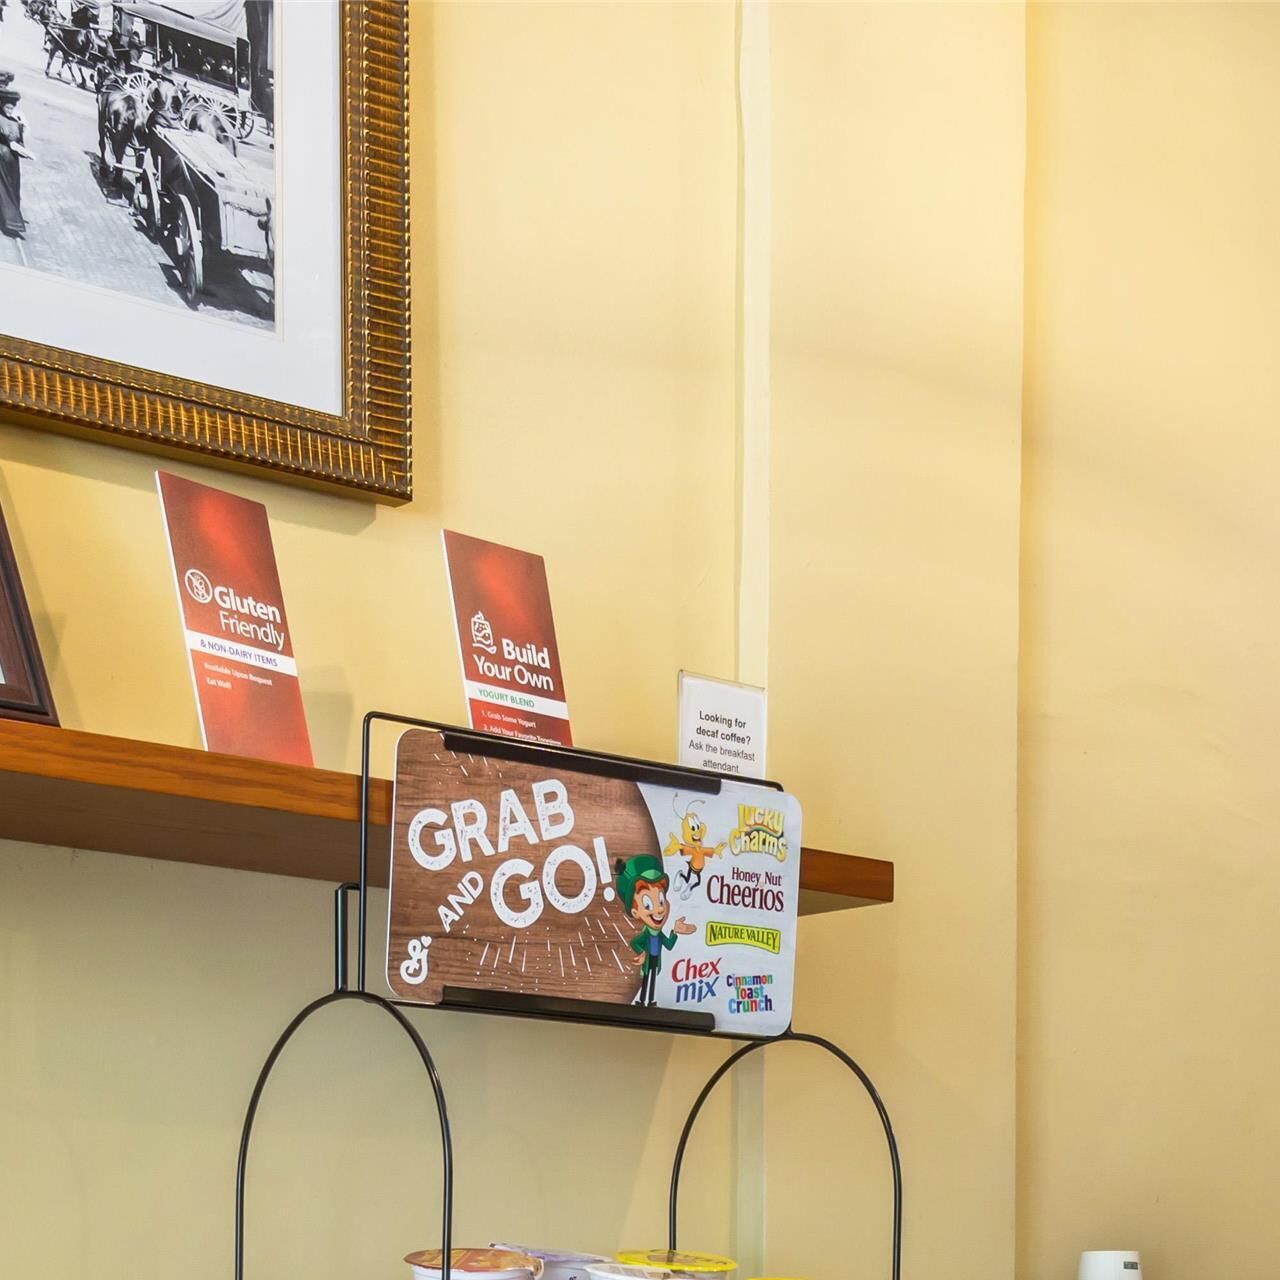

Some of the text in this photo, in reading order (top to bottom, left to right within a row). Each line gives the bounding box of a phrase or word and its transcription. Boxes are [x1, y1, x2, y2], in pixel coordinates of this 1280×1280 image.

[214, 586, 281, 624] Gluten
[219, 610, 285, 651] Friendly
[208, 640, 253, 659] NON-DAIRY
[254, 654, 279, 667] ITEMS
[501, 638, 551, 669] Build
[473, 654, 554, 691] Your Own
[478, 688, 535, 708] YOGURT BLEND
[518, 718, 536, 728] Yogurt
[699, 710, 747, 729] Looking for
[696, 726, 751, 745] decaf coffee?
[689, 740, 756, 762] Ask the breakfast
[407, 778, 575, 872] GRAB
[736, 803, 785, 836] Lucky
[729, 827, 788, 863] Charms
[437, 836, 615, 934] AND GO!
[732, 867, 782, 888] Honey Nut
[707, 874, 785, 912] Cheerios
[709, 924, 779, 951] NATURE VALLEY
[671, 957, 722, 983] Chex
[676, 976, 720, 1003] mix
